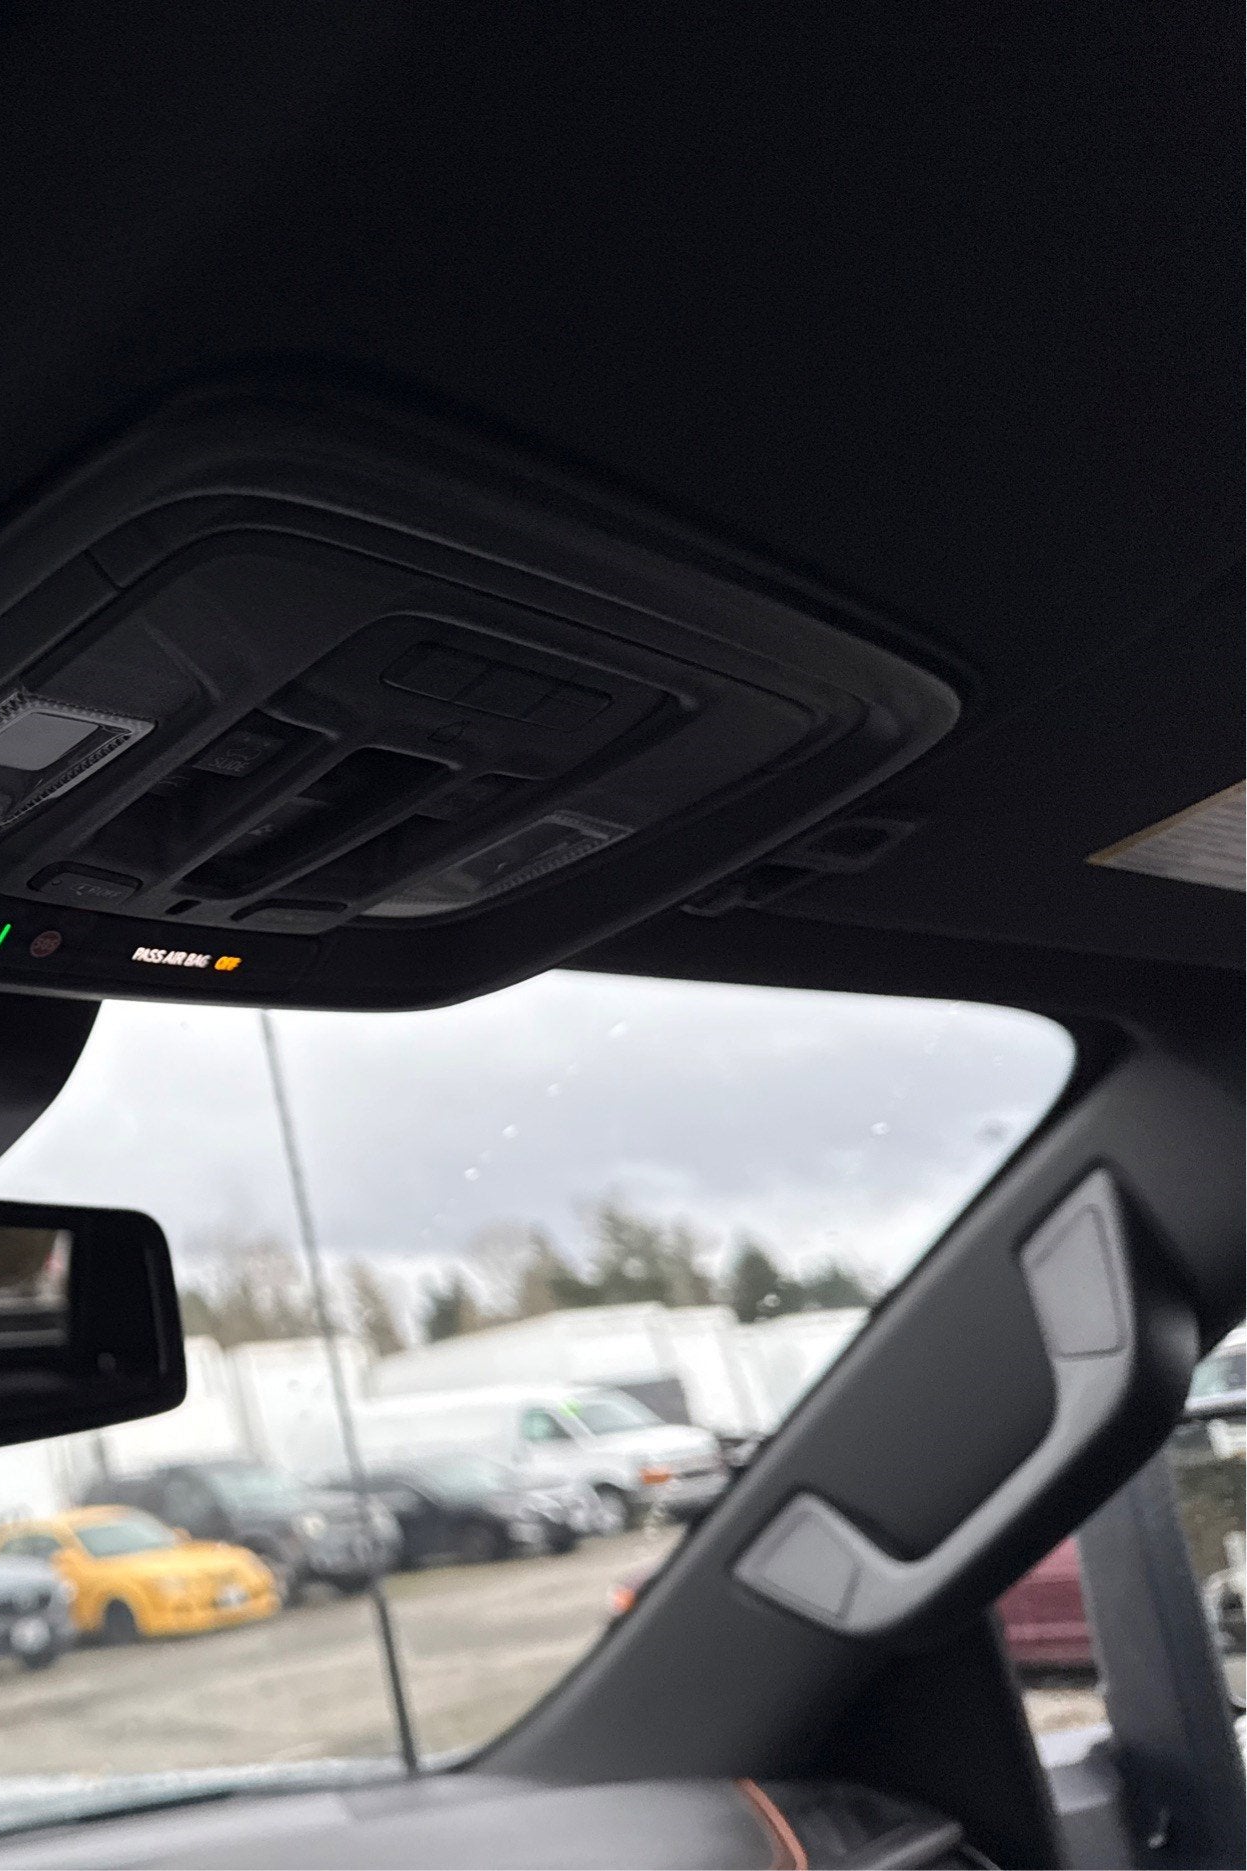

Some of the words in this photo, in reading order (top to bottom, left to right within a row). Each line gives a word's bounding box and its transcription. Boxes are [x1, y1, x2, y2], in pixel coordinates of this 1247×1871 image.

[131, 946, 167, 964] PASS
[161, 950, 188, 966] AIR
[183, 952, 213, 969] BAG
[214, 955, 243, 971] OFF
